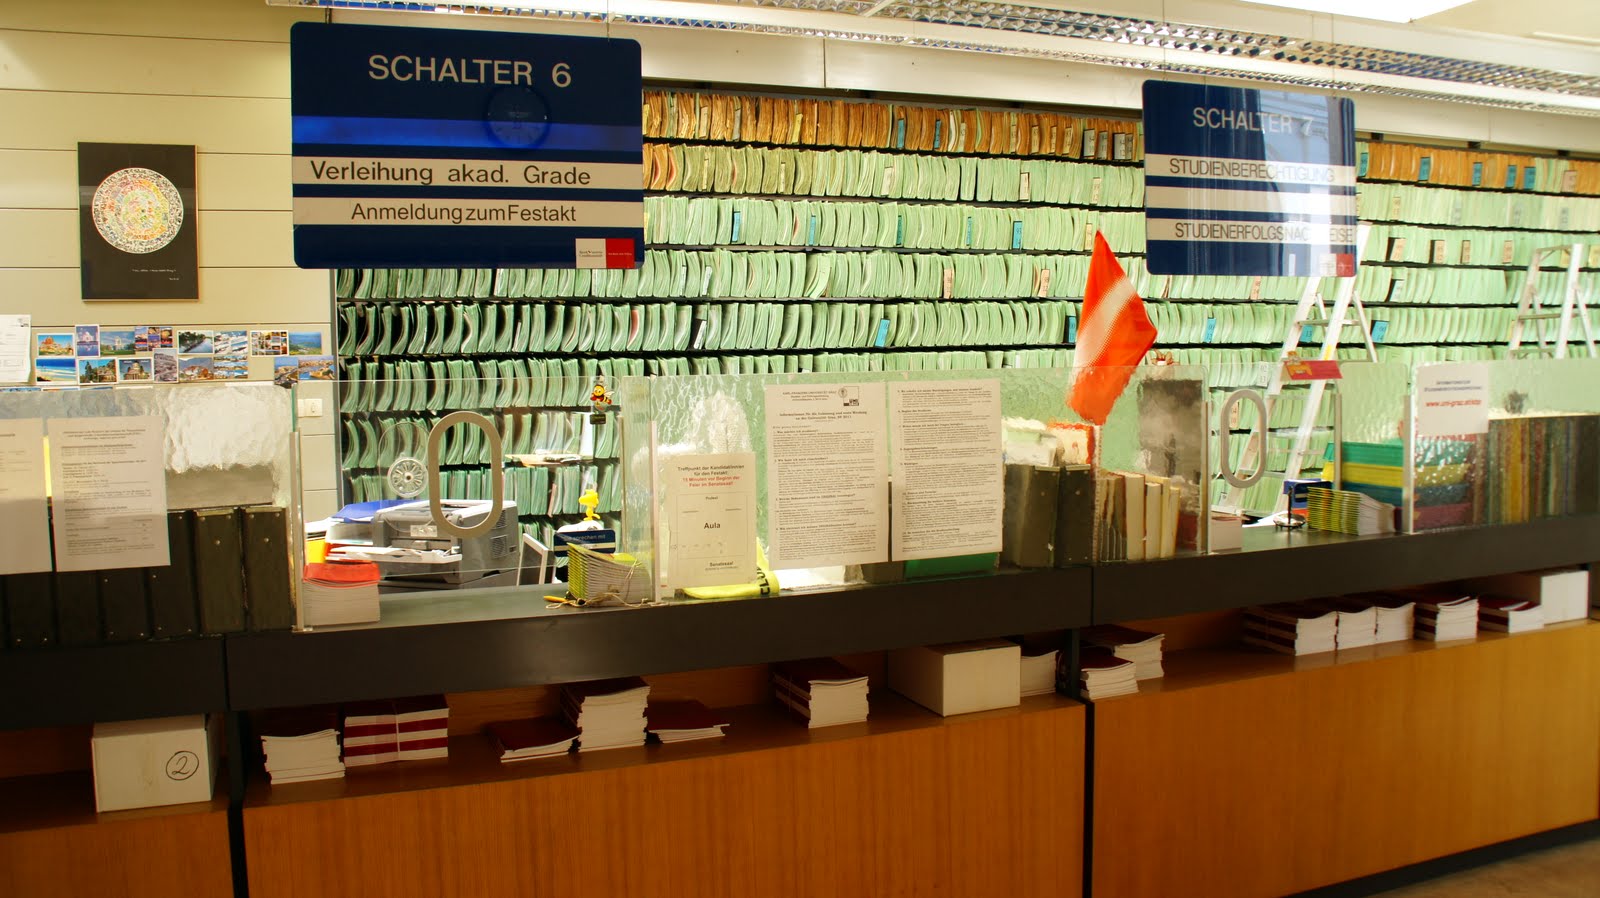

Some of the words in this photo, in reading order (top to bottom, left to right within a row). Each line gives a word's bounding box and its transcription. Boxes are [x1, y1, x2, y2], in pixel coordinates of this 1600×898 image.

[368, 54, 533, 86] SCHALTER
[551, 62, 573, 88] 6
[1193, 107, 1292, 134] SCHALTER
[1301, 116, 1314, 137] 7
[310, 159, 433, 186] Verleihung
[447, 163, 509, 184] akad.
[523, 164, 591, 185] Grade
[1175, 222, 1354, 243] STUDIENERFOLGSNACEISE
[171, 755, 190, 776] 2
